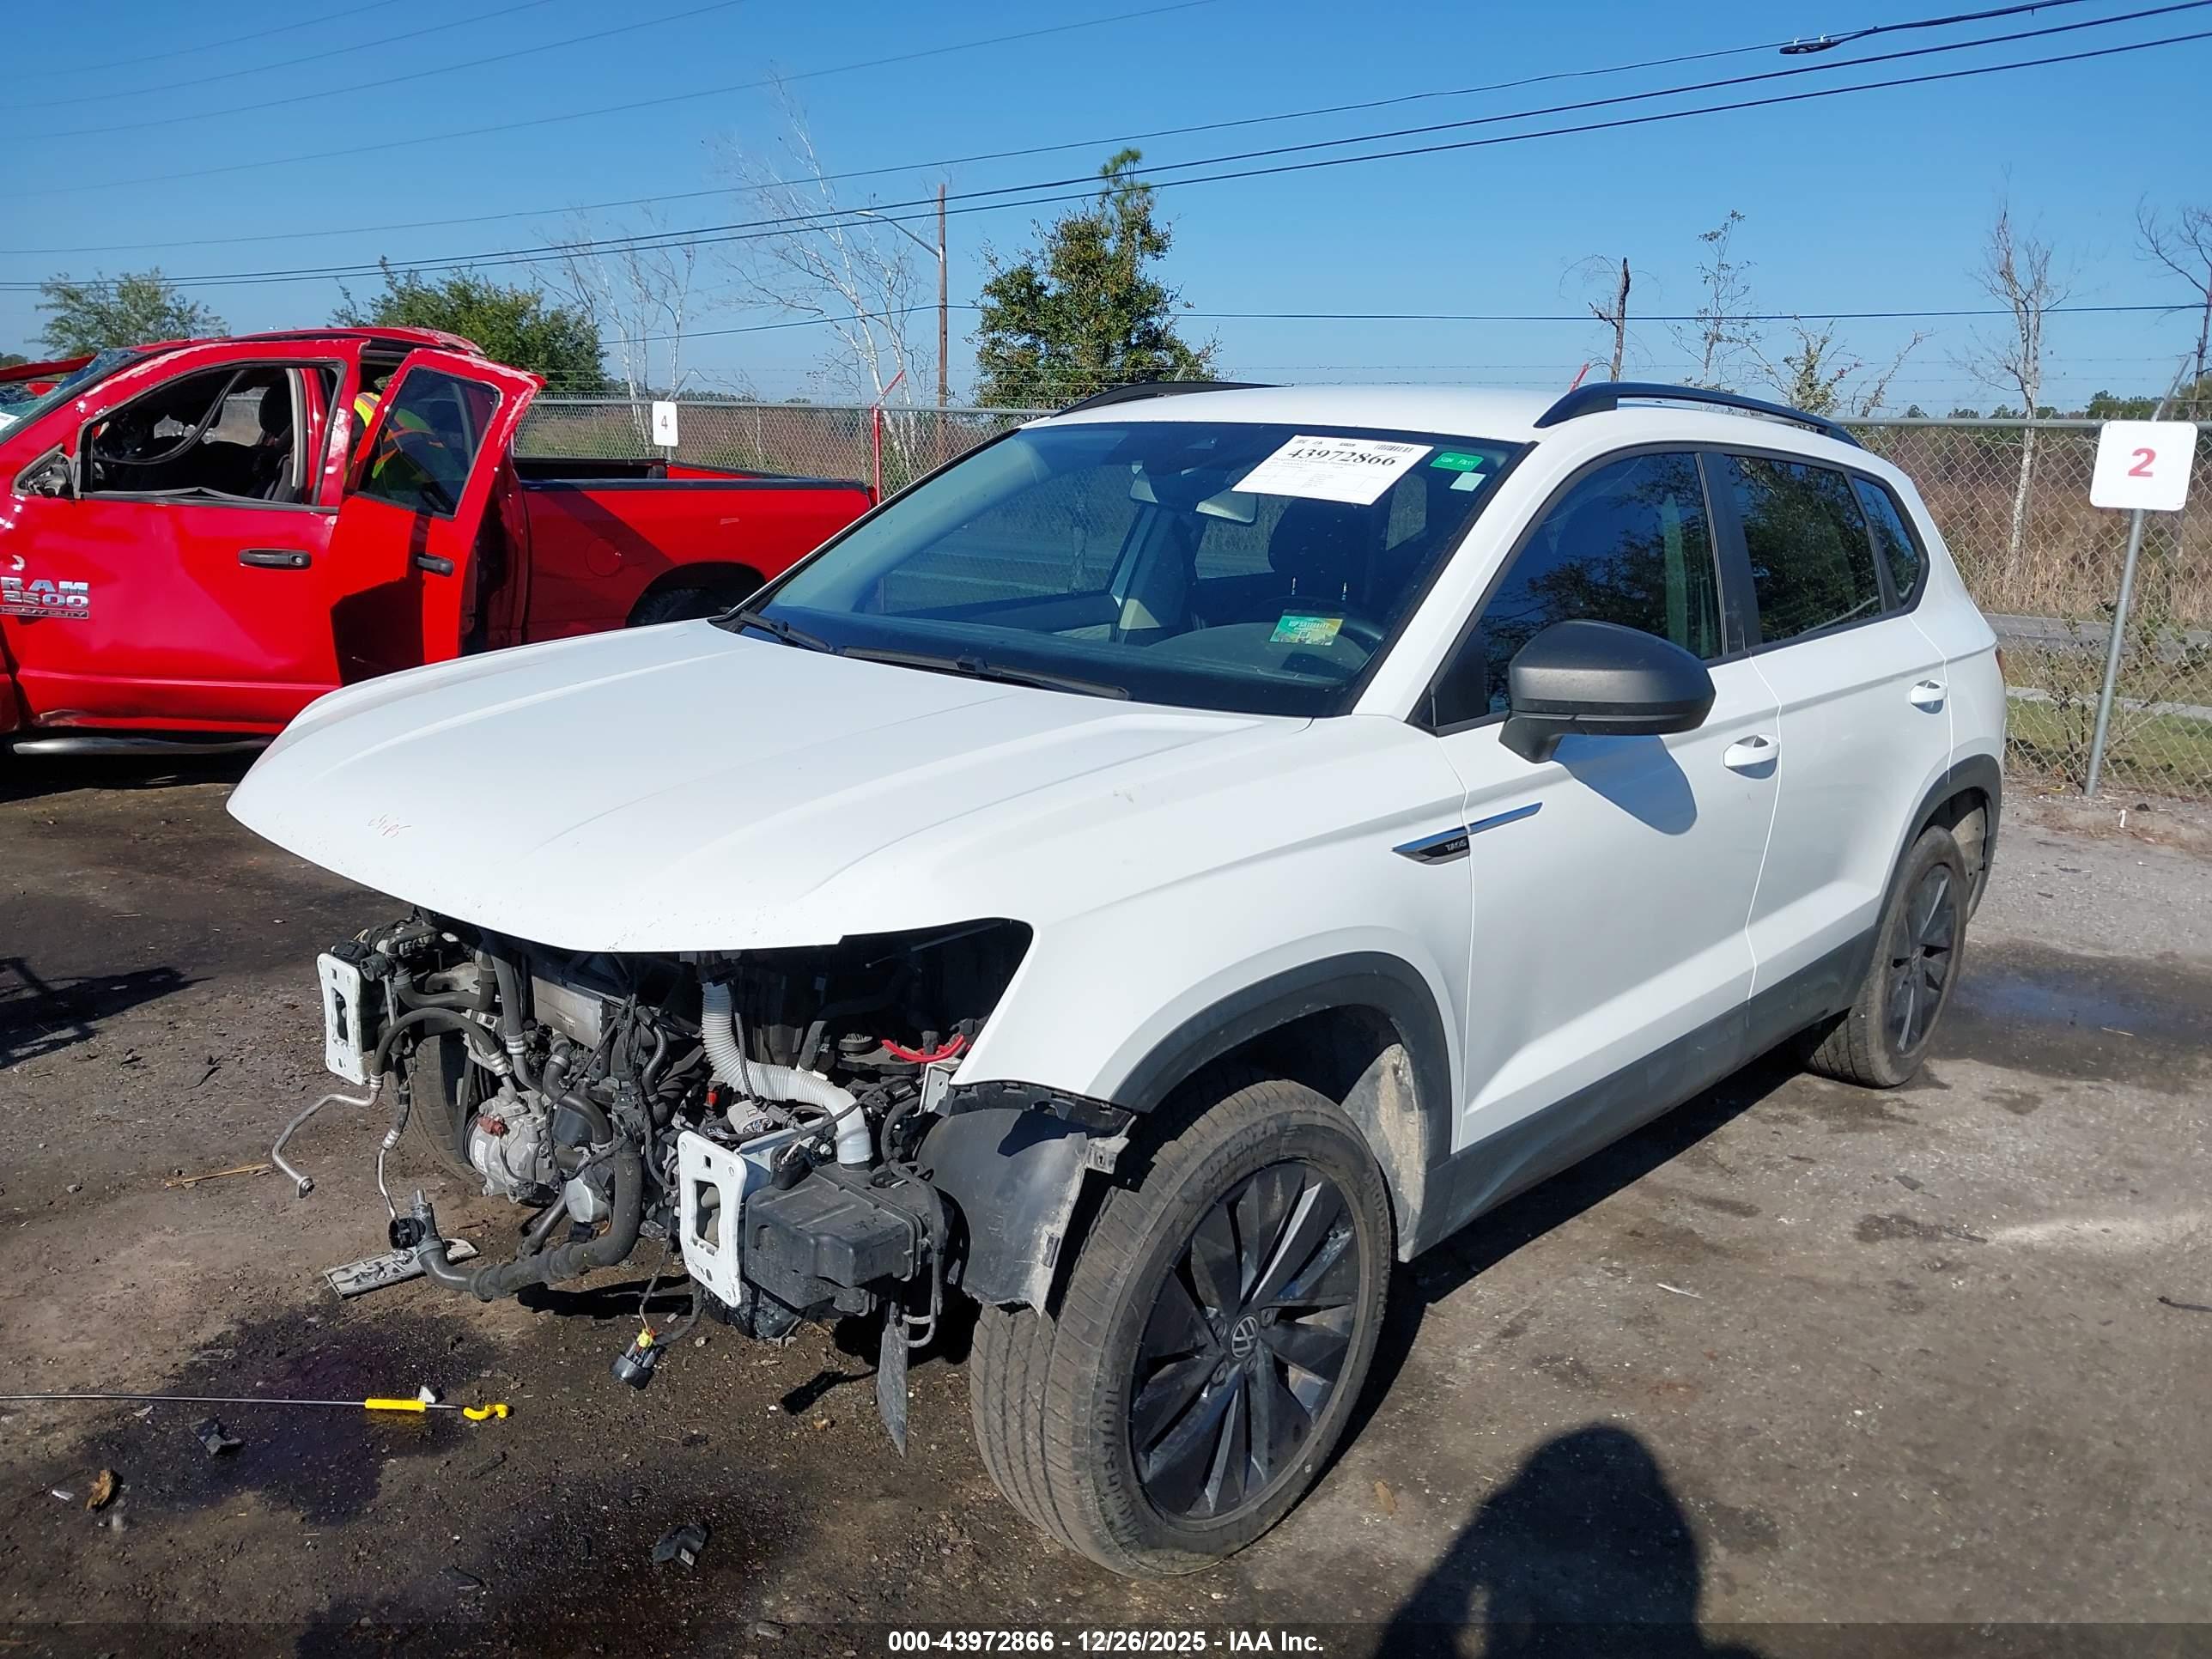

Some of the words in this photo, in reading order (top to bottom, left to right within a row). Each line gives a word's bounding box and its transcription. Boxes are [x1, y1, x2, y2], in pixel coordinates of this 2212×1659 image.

[660, 415, 668, 429] 4
[1287, 448, 1402, 466] 43972866
[2128, 447, 2156, 477] 2
[0, 576, 88, 595] RAM
[3, 590, 88, 608] 2500
[1445, 839, 1467, 851] TAOS
